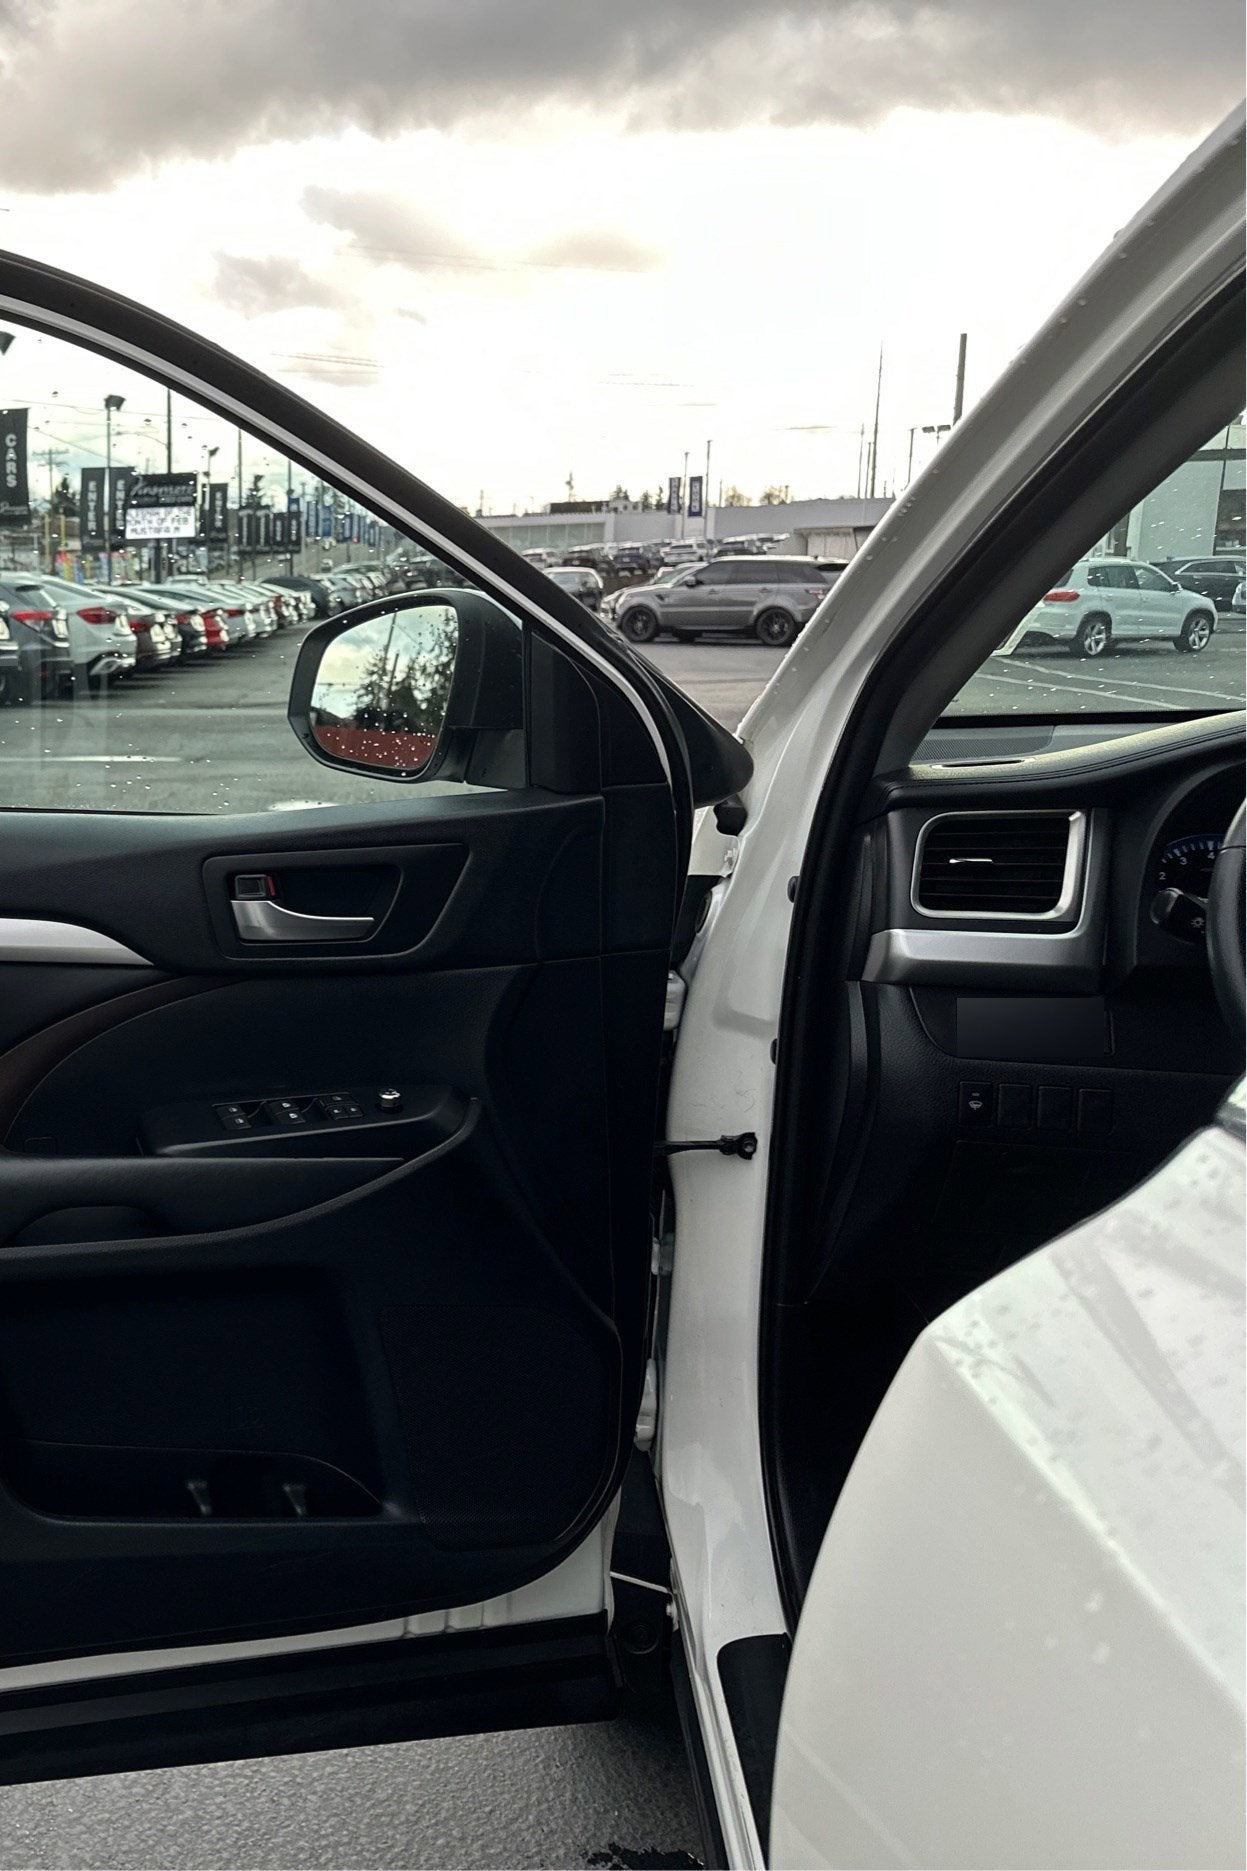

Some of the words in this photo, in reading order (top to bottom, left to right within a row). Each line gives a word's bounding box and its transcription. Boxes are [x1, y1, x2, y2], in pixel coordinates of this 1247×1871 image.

[5, 433, 17, 488] CARS
[87, 480, 97, 531] ENTER
[1158, 871, 1167, 880] 2
